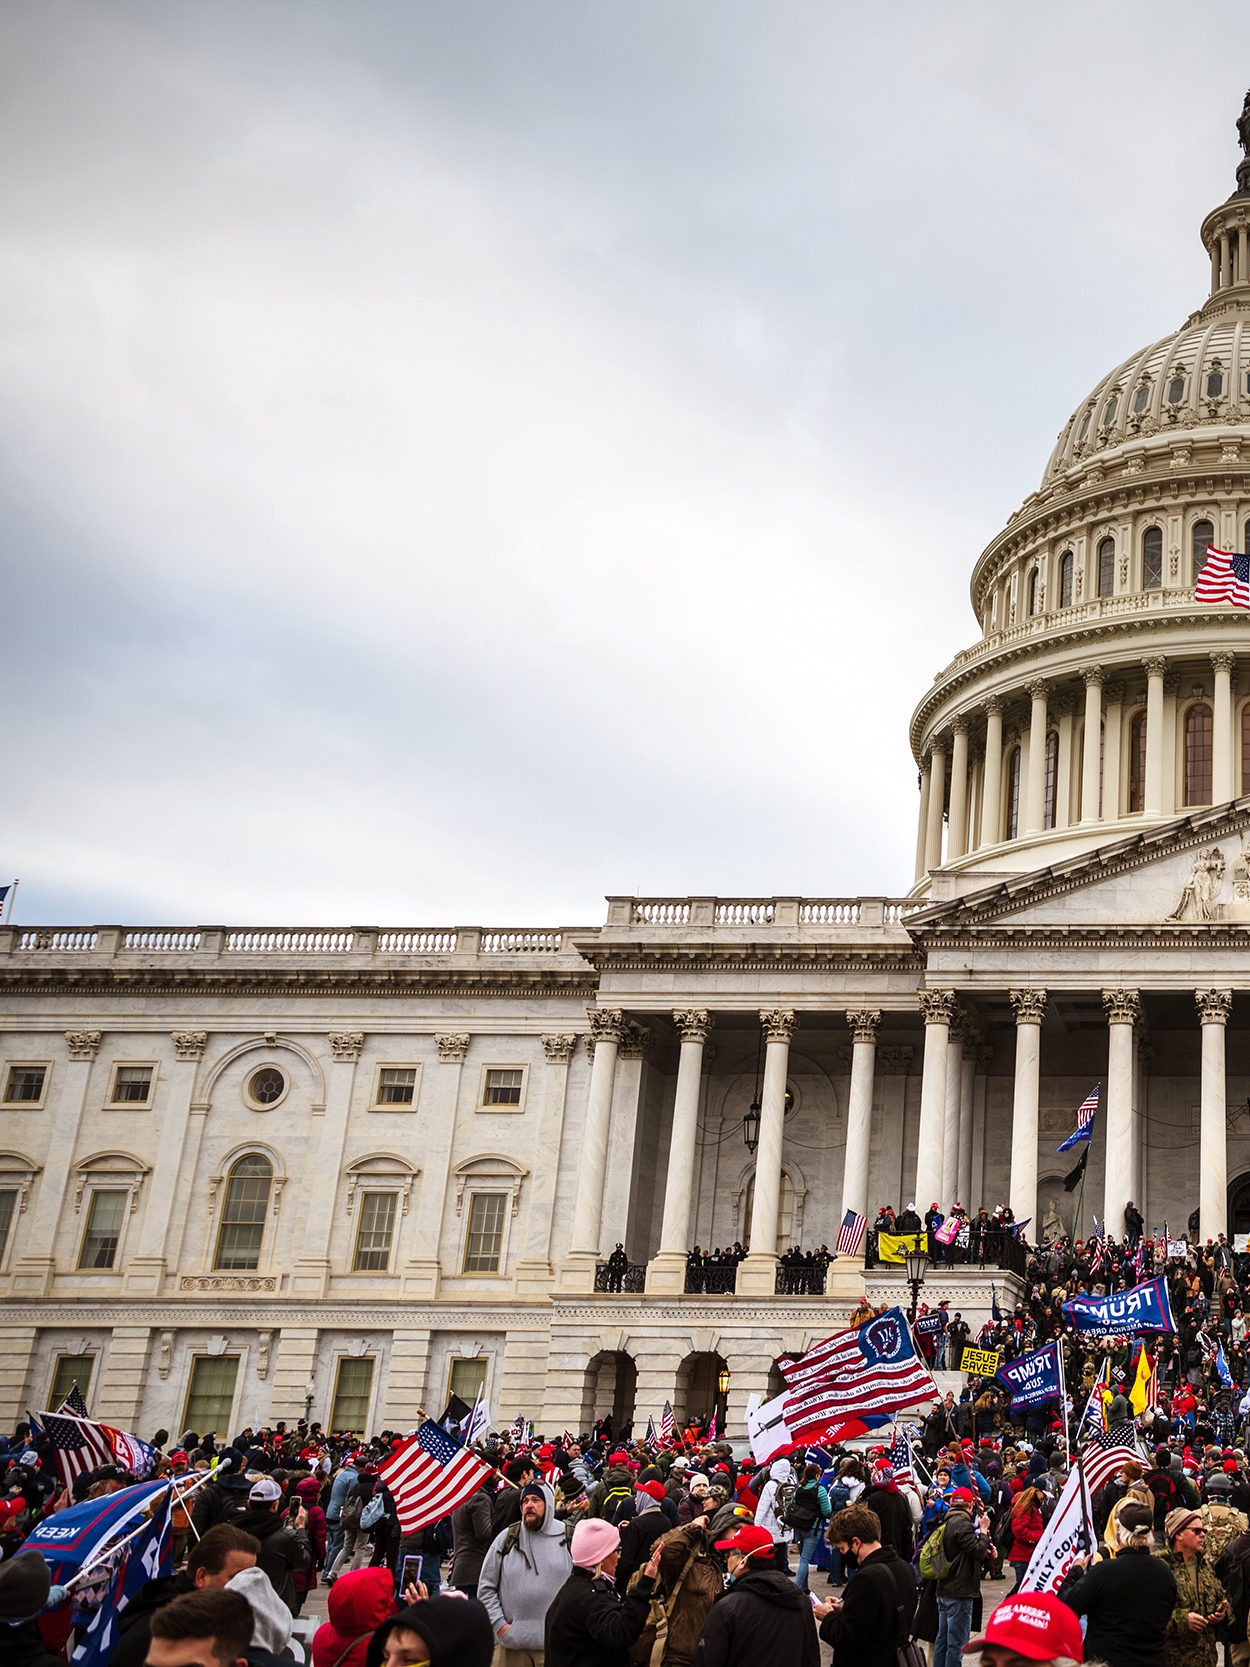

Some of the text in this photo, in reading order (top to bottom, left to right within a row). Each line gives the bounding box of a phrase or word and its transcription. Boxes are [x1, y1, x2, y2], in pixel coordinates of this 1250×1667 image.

[964, 1350, 996, 1364] JESUS
[961, 1360, 995, 1374] SAVES
[1033, 1558, 1056, 1593] MILY
[1011, 1604, 1051, 1621] AMERICA
[1018, 1613, 1049, 1630] AGAIN!
